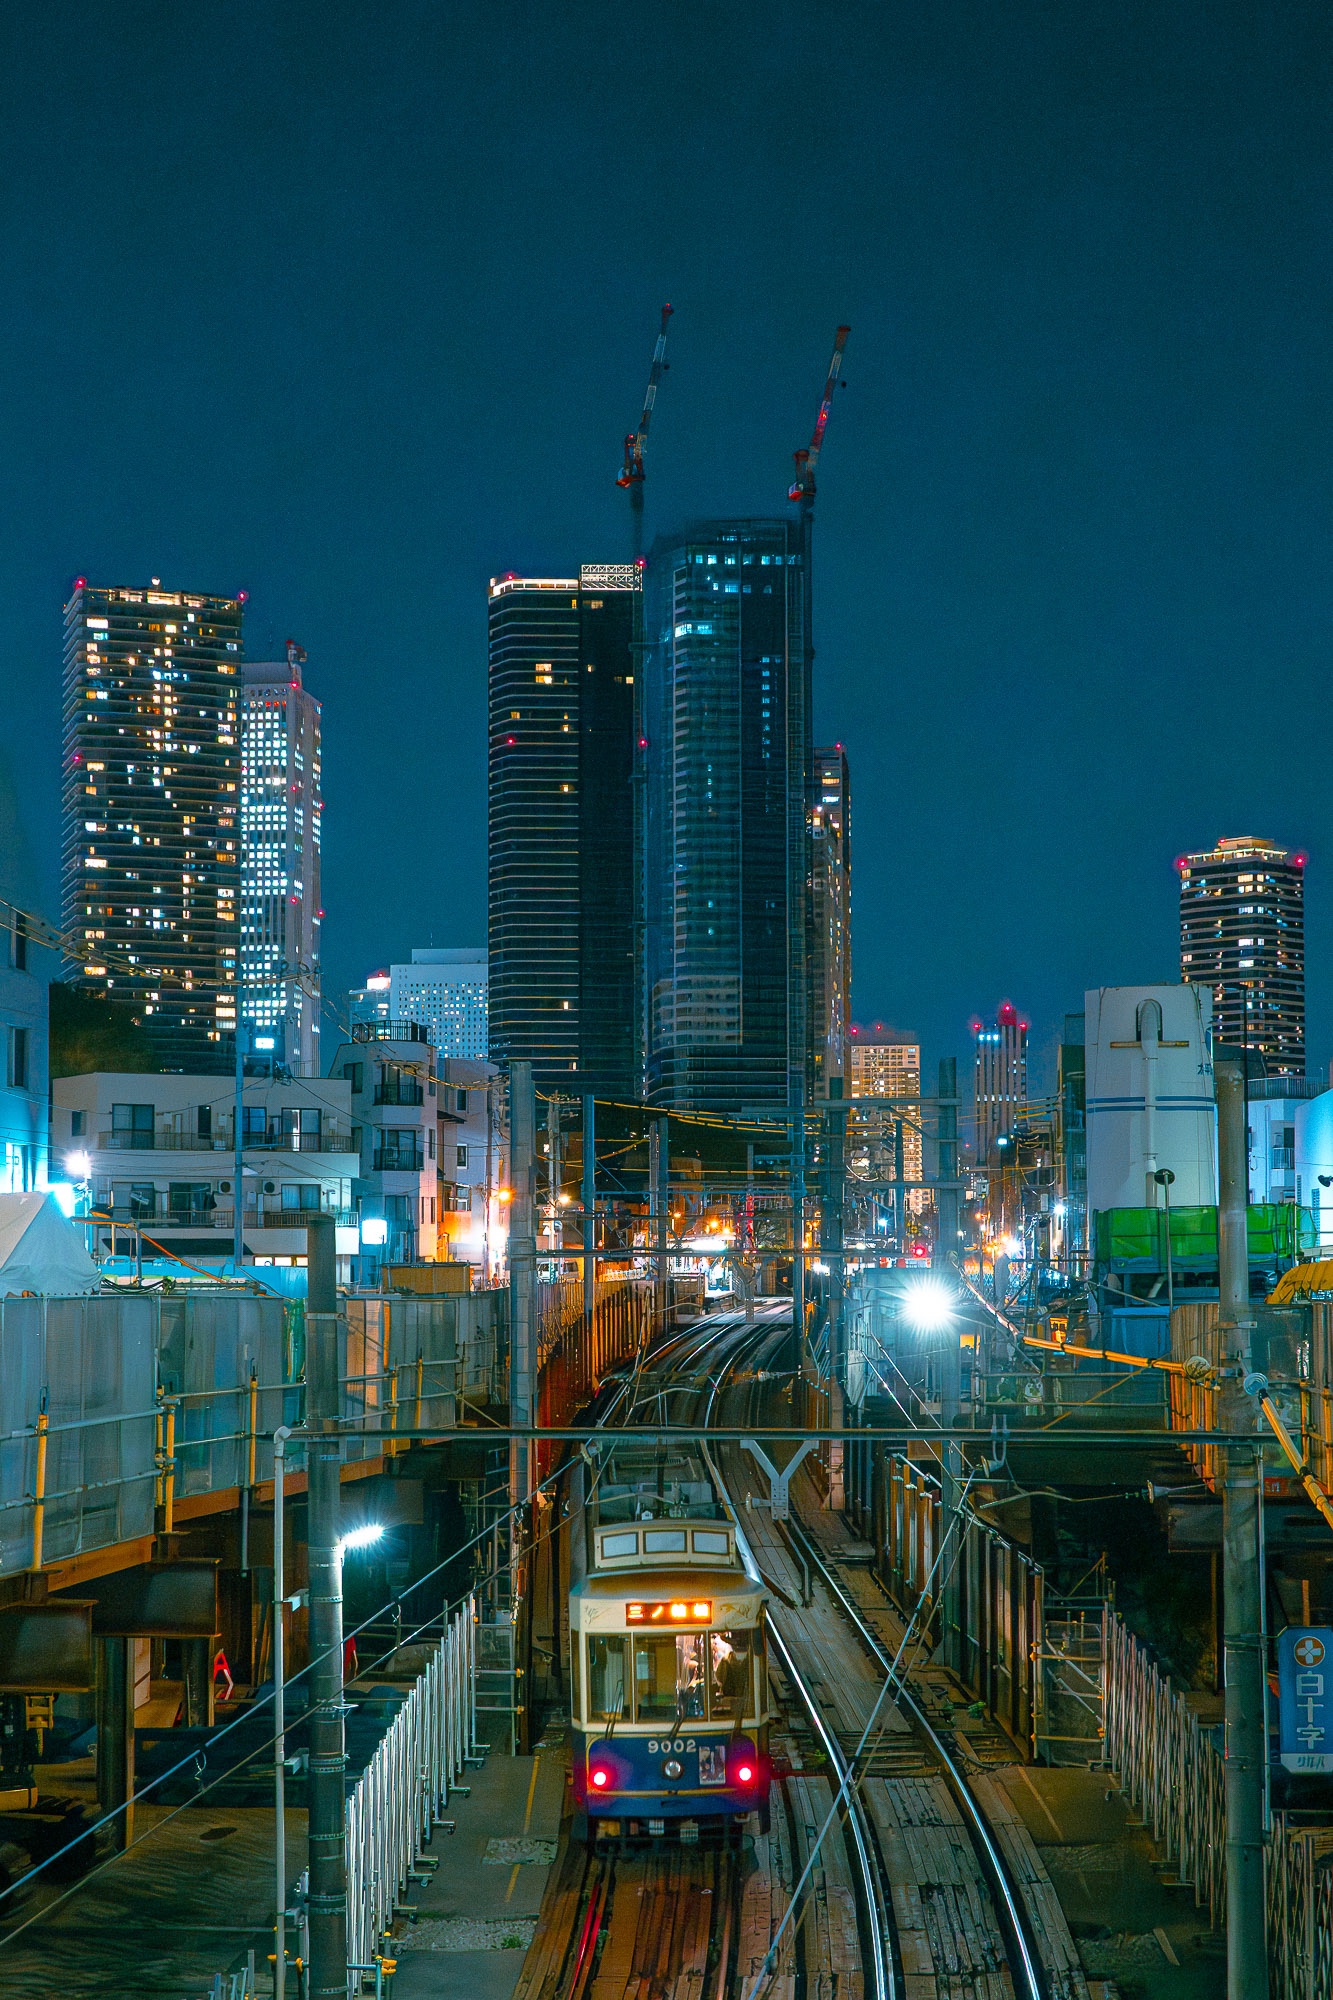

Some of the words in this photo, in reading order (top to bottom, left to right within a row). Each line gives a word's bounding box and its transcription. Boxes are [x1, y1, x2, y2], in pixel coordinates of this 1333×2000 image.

[628, 1603, 709, 1618] 三ノ
[1296, 1670, 1325, 1750] 白十字
[648, 1739, 696, 1754] 9002
